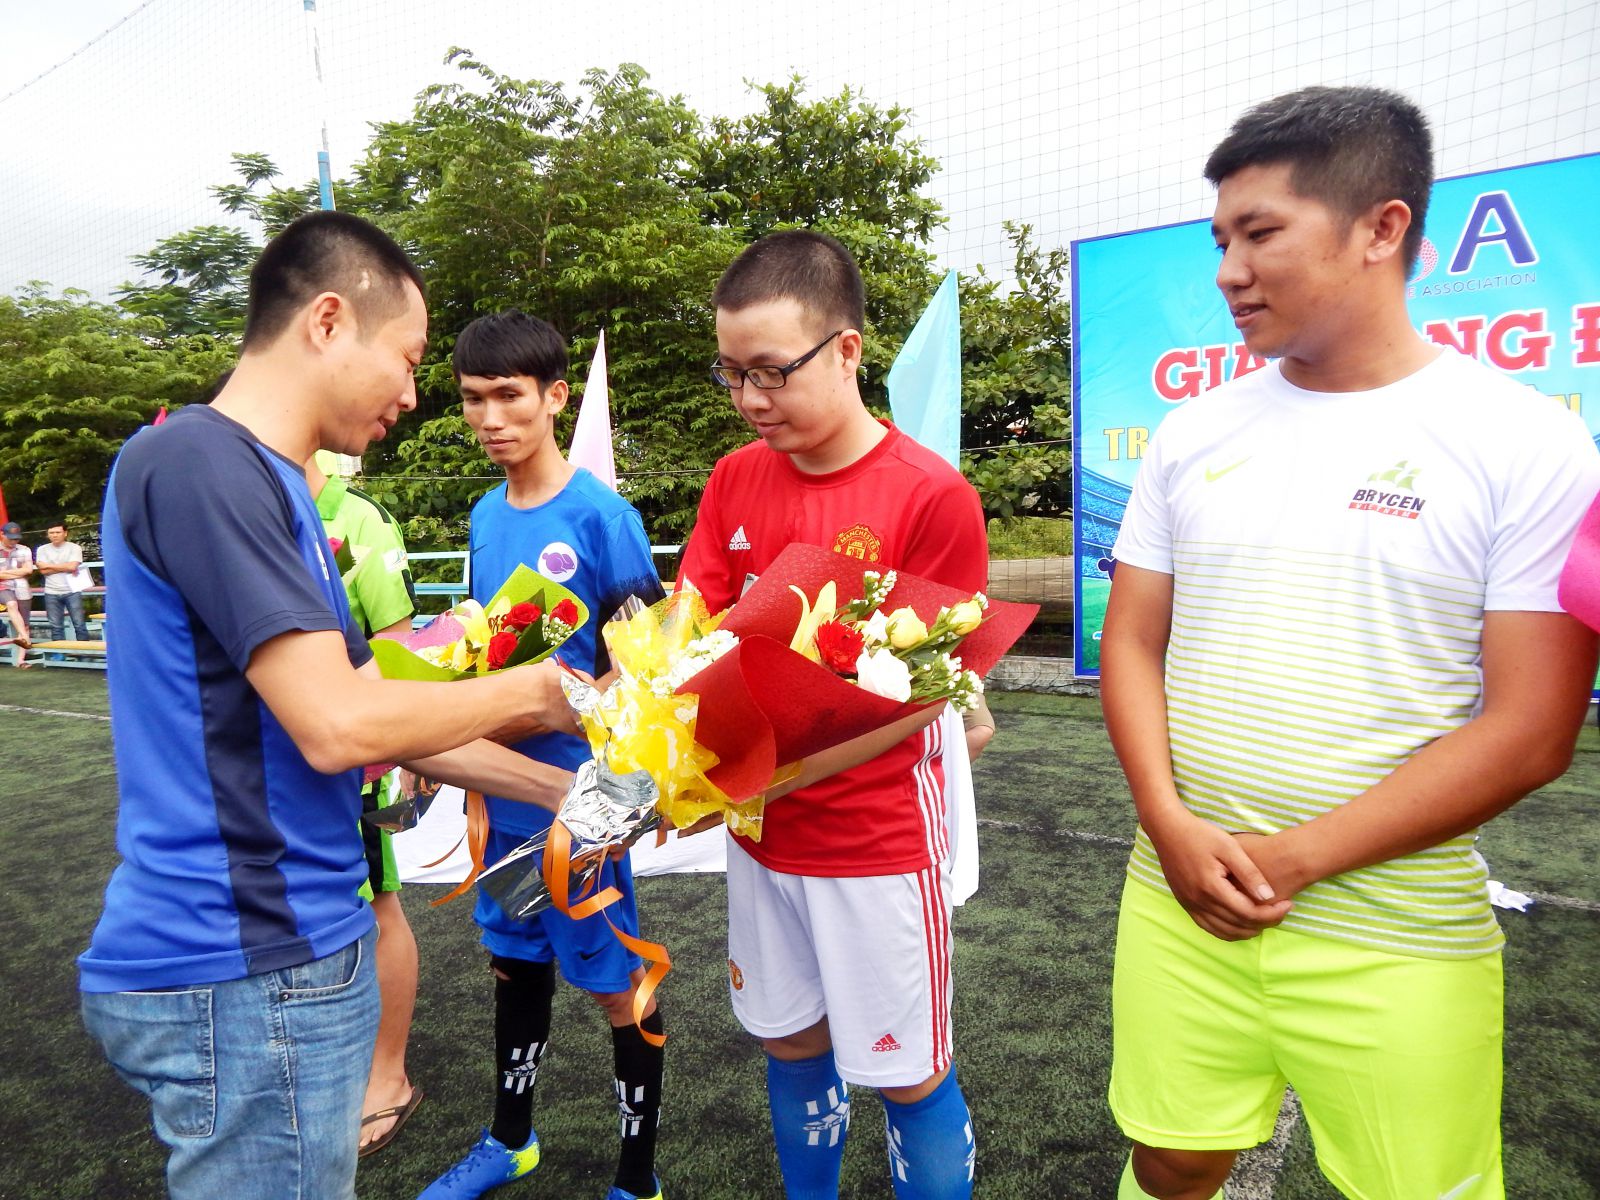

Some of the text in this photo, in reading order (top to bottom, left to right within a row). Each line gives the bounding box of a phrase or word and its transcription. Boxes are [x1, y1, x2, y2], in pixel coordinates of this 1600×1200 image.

[1421, 271, 1537, 297] ASSOCIATION
[1425, 311, 1552, 371] NG
[1352, 488, 1427, 512] BRYCEN
[728, 541, 752, 551] adidas
[840, 529, 877, 551] MANCHESTER
[871, 1043, 902, 1052] adidas
